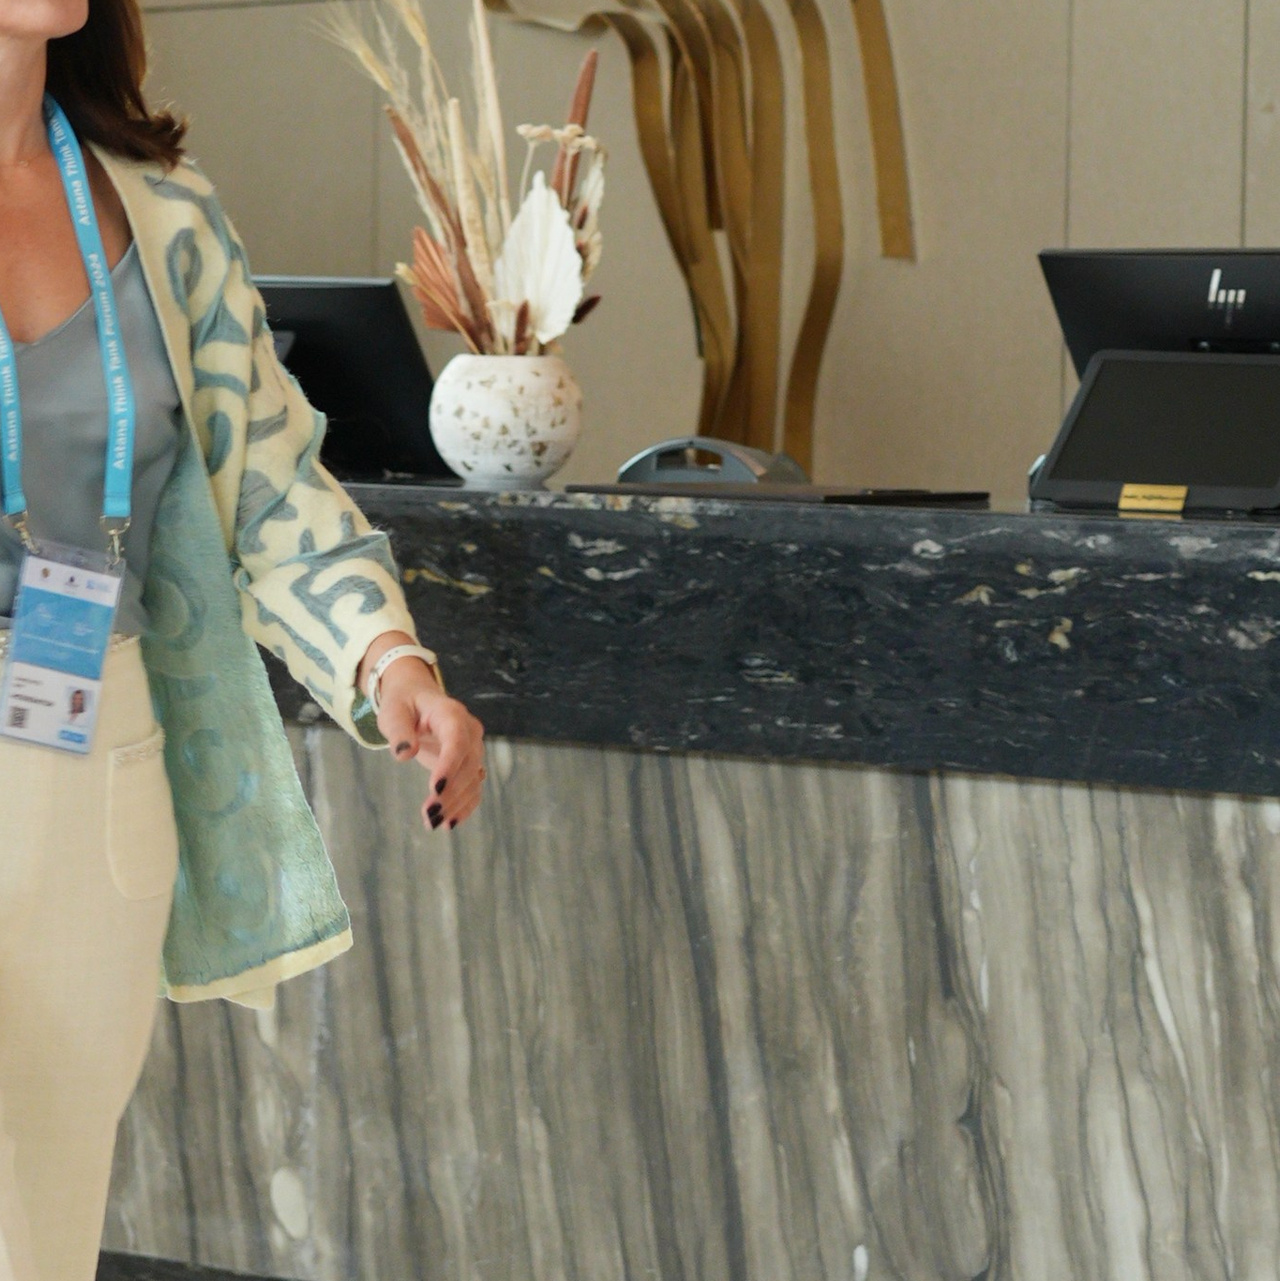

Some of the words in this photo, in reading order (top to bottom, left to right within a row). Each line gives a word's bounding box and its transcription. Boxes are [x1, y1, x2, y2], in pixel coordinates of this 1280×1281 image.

[59, 143, 79, 177] Think
[71, 180, 91, 226] Astana
[88, 253, 106, 288] 2024
[100, 291, 115, 336] Forum
[107, 340, 121, 371] Tank
[1, 365, 15, 406] Think
[113, 375, 128, 412] Think
[7, 410, 19, 461] Astana
[113, 419, 128, 470] Astana
